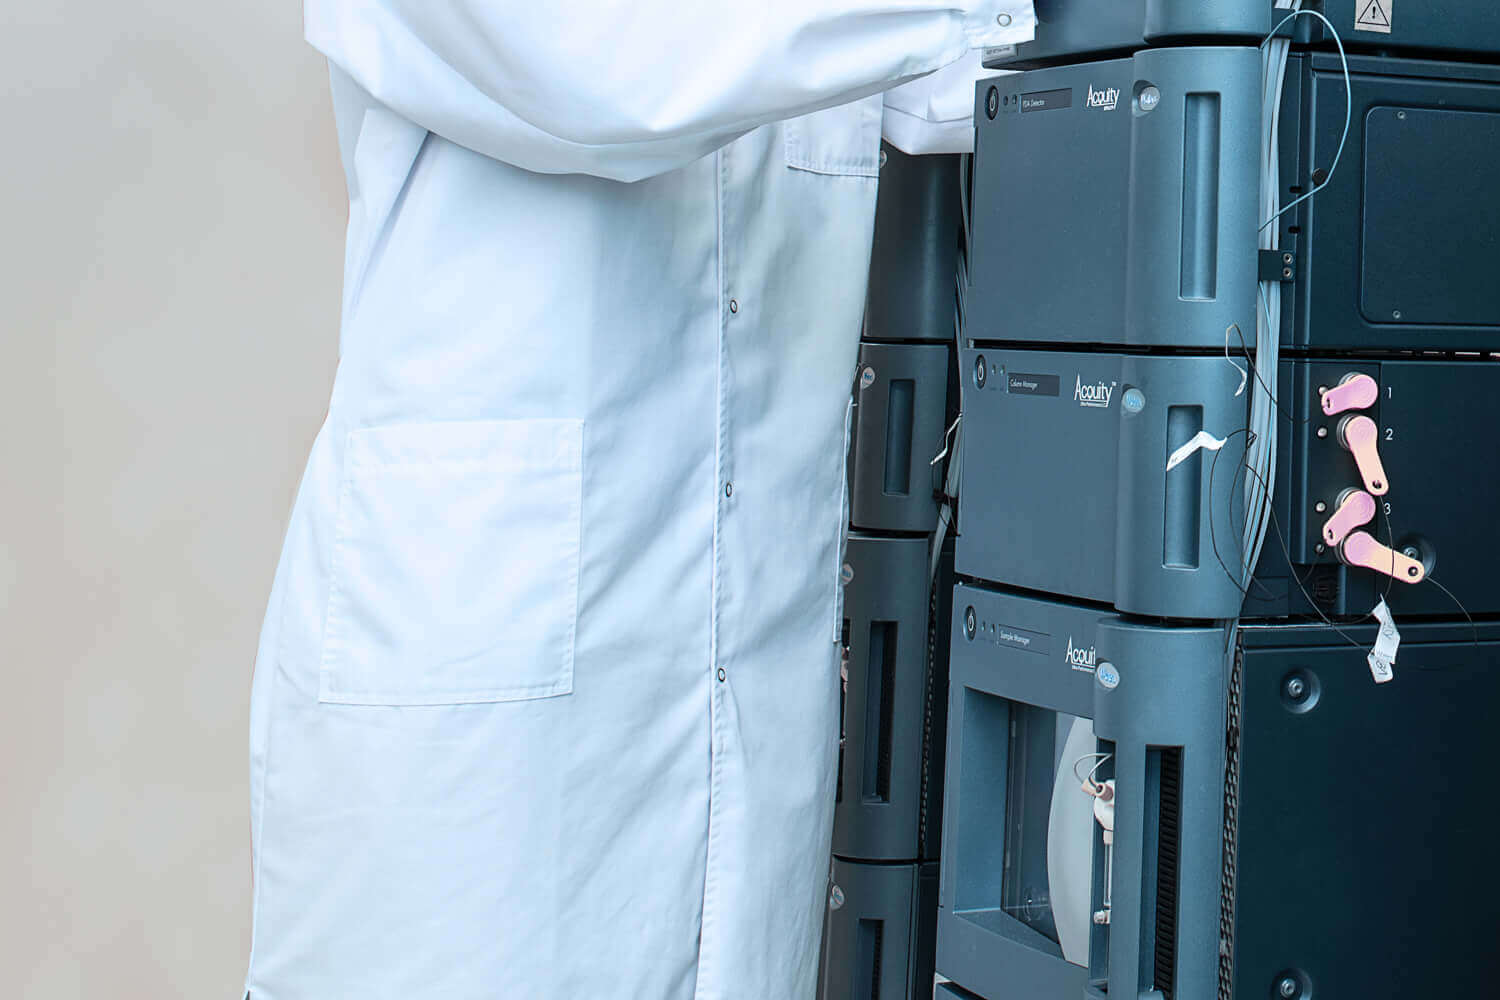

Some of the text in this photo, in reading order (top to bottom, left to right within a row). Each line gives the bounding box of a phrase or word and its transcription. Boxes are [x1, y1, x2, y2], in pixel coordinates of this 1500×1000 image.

[1086, 84, 1120, 111] Acquity
[1387, 387, 1392, 399] 1
[1385, 428, 1393, 440] 2
[1384, 502, 1391, 515] 3
